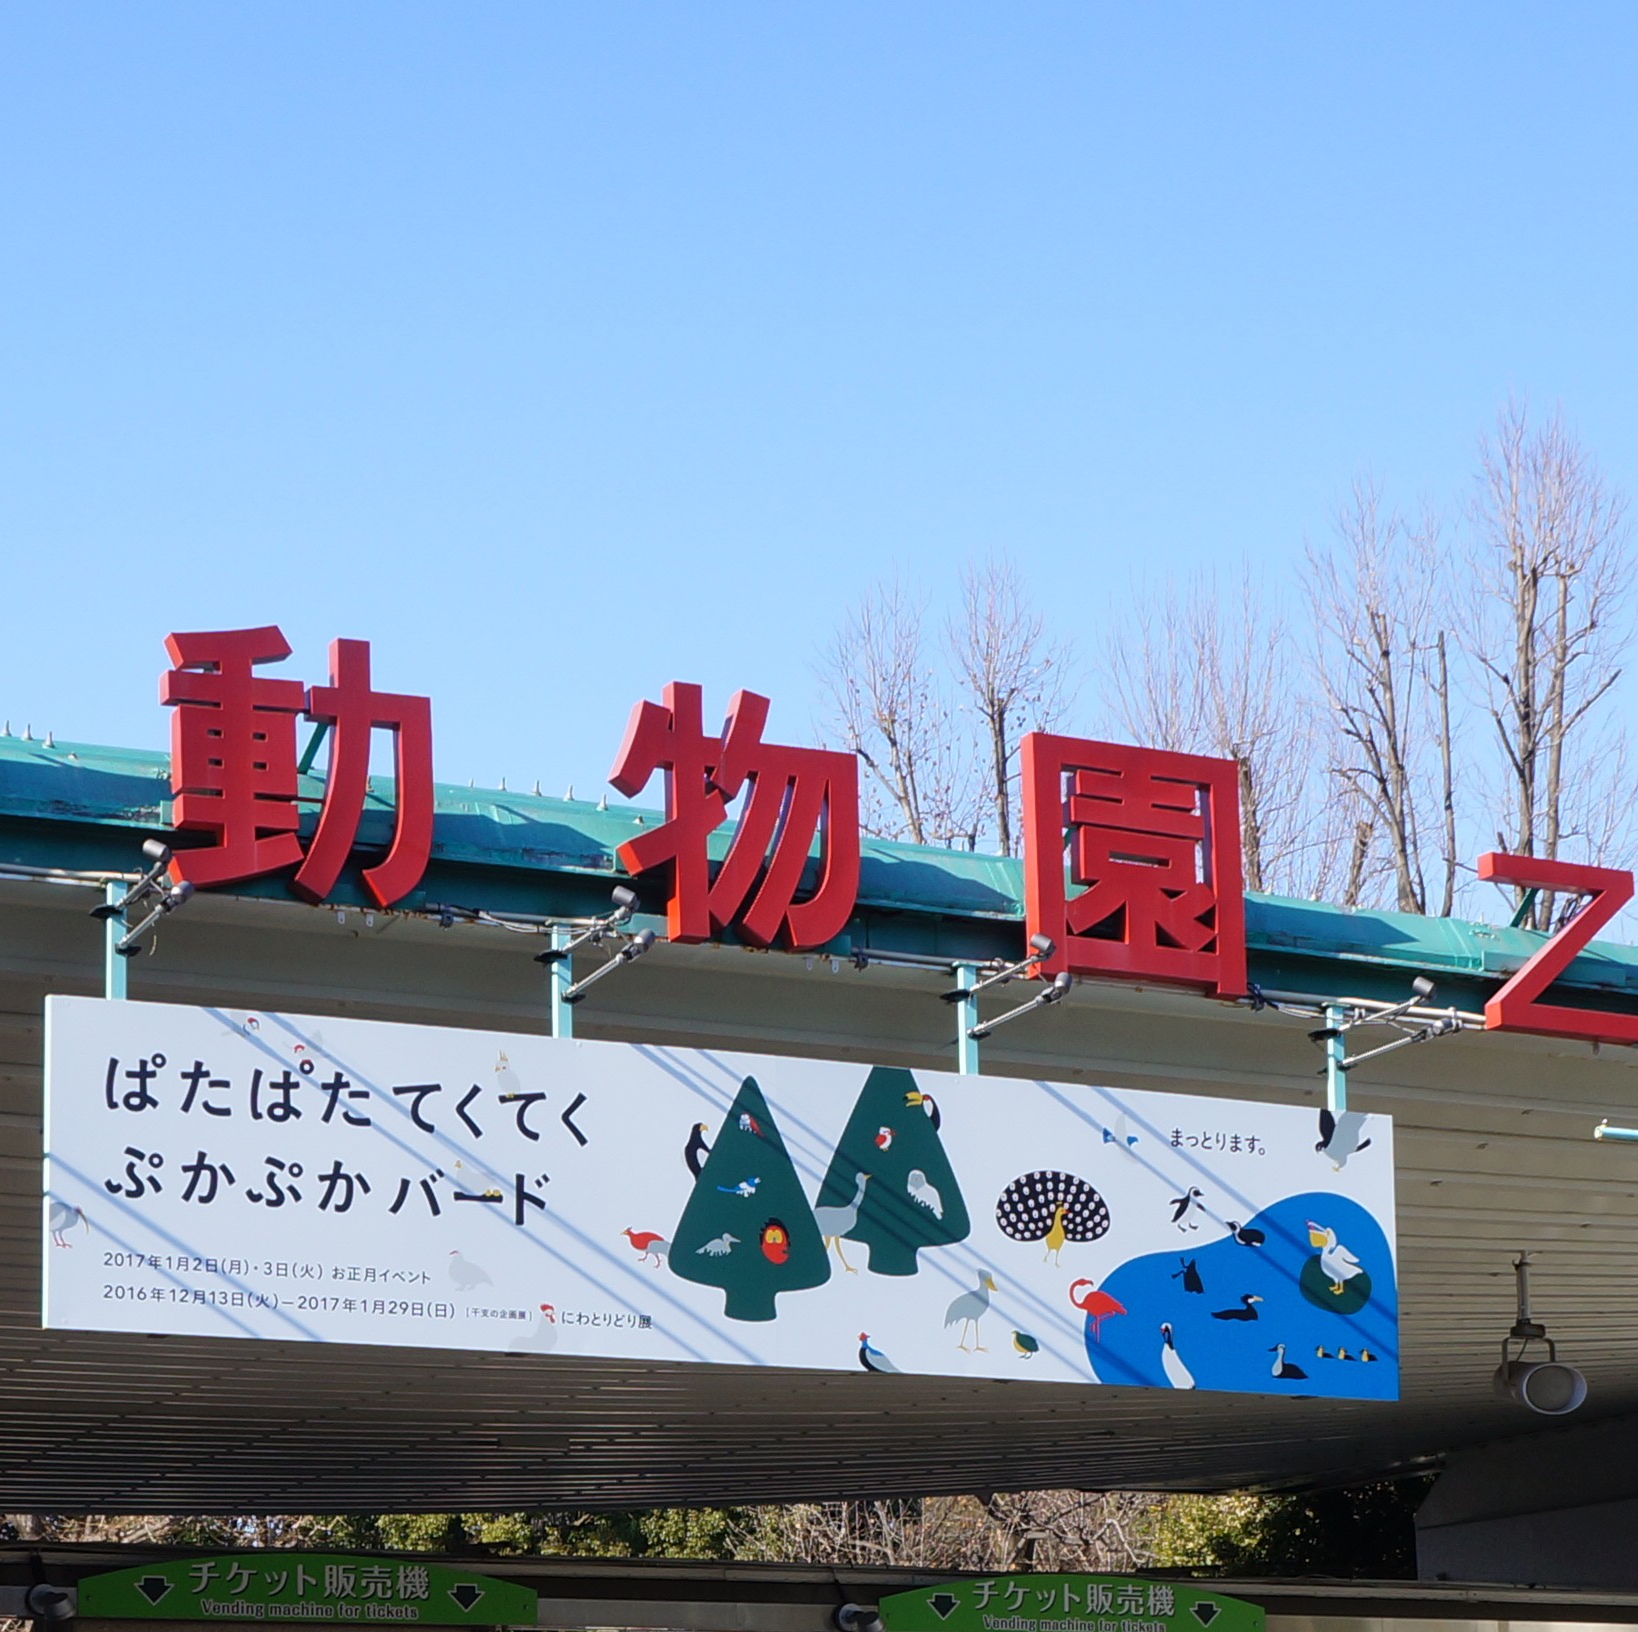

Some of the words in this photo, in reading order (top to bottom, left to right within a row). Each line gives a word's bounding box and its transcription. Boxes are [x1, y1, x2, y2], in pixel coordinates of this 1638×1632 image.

[105, 1053, 588, 1147] ぱたぱたてくてく
[1169, 1128, 1265, 1156] まっとります。
[104, 1146, 550, 1226] ぷかぷかバード
[331, 1265, 431, 1285] お正月イベント
[562, 1309, 652, 1329] にわとりどり展
[189, 1561, 428, 1599] チケット販売機
[201, 1600, 264, 1617] Vending
[269, 1602, 333, 1618] machine
[338, 1602, 360, 1618] for
[366, 1603, 418, 1619] tickets
[973, 1581, 1174, 1617] チケット販売機
[983, 1616, 1037, 1632] Vending
[1041, 1617, 1095, 1632] machine
[1098, 1619, 1117, 1632] for
